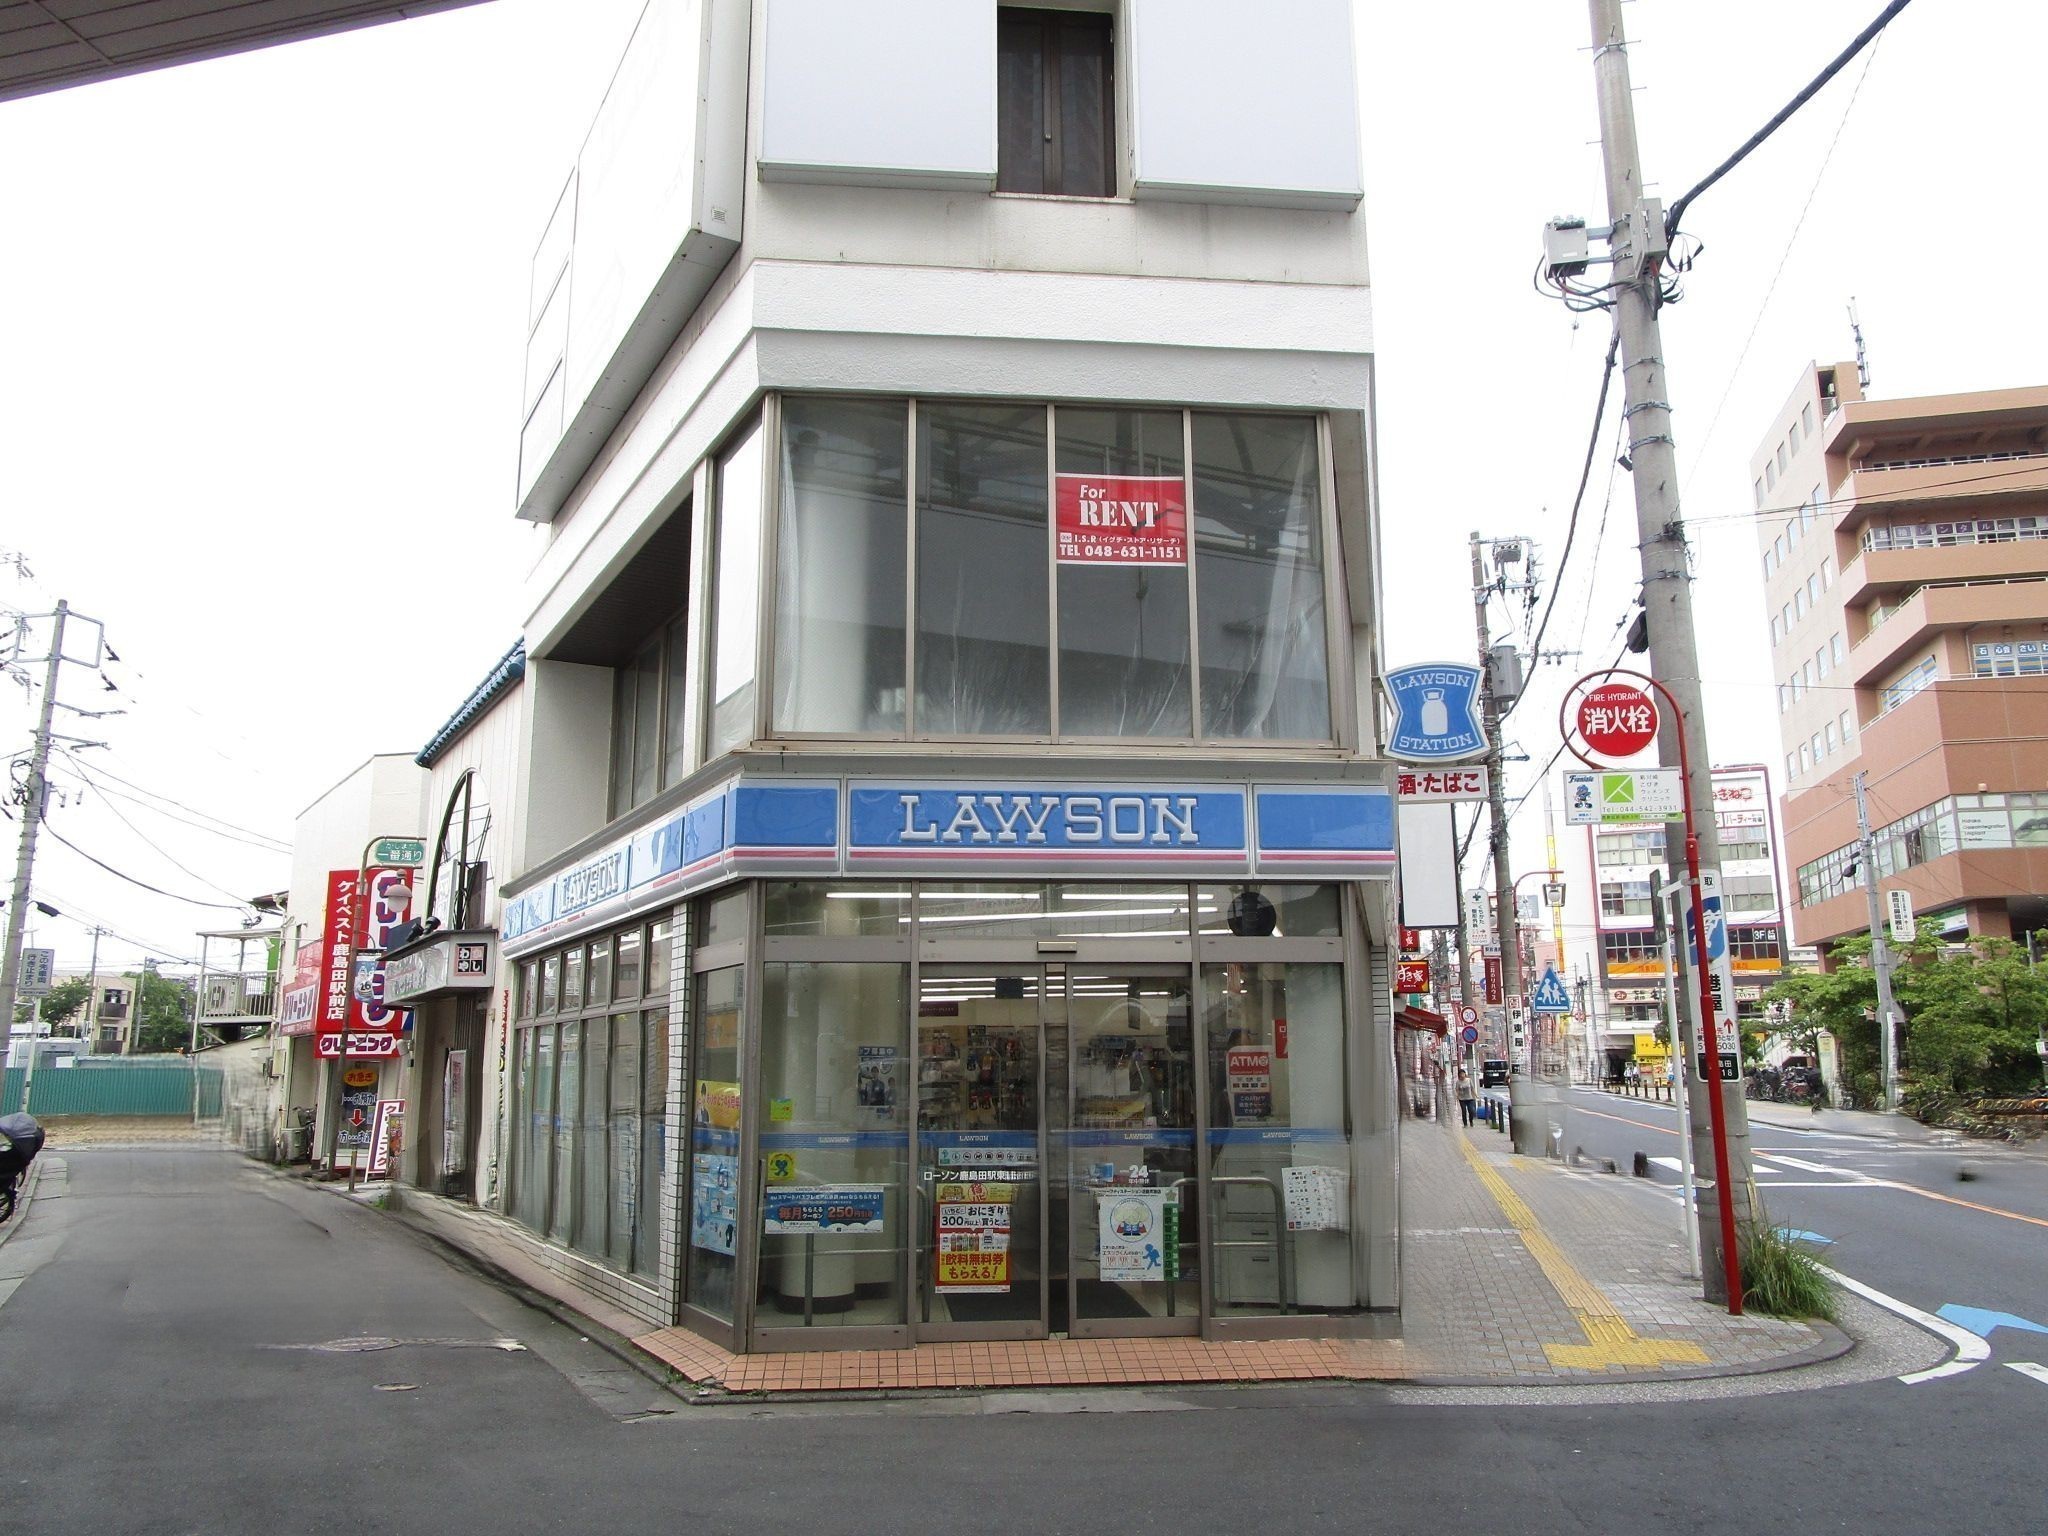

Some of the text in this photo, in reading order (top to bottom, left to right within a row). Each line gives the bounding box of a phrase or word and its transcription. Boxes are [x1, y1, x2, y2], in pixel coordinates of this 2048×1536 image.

[1080, 485, 1106, 498] For
[1079, 500, 1159, 527] RENT
[1060, 544, 1181, 559] TEL 048-631-1151
[1396, 673, 1470, 691] LAWSON
[1588, 691, 1642, 702] FIRE HYDRANT
[1584, 704, 1652, 735] 消火栓
[1400, 733, 1473, 751] STATION
[900, 796, 1199, 843] LAWSON
[377, 849, 422, 862] 一番通り
[561, 852, 621, 913] LAWSON
[1754, 930, 1765, 940] 3F
[327, 880, 355, 1020] ケイベスト鹿島田駅前店
[1398, 965, 1424, 983] すき家
[360, 982, 371, 991] 26
[1464, 1012, 1475, 1021] 30
[1512, 1010, 1524, 1047] 伊東屋
[321, 1037, 393, 1052] クリーニング
[1230, 1056, 1259, 1066] ATM
[1129, 1164, 1149, 1178] 24
[946, 1254, 1004, 1266] 飲料無料券
